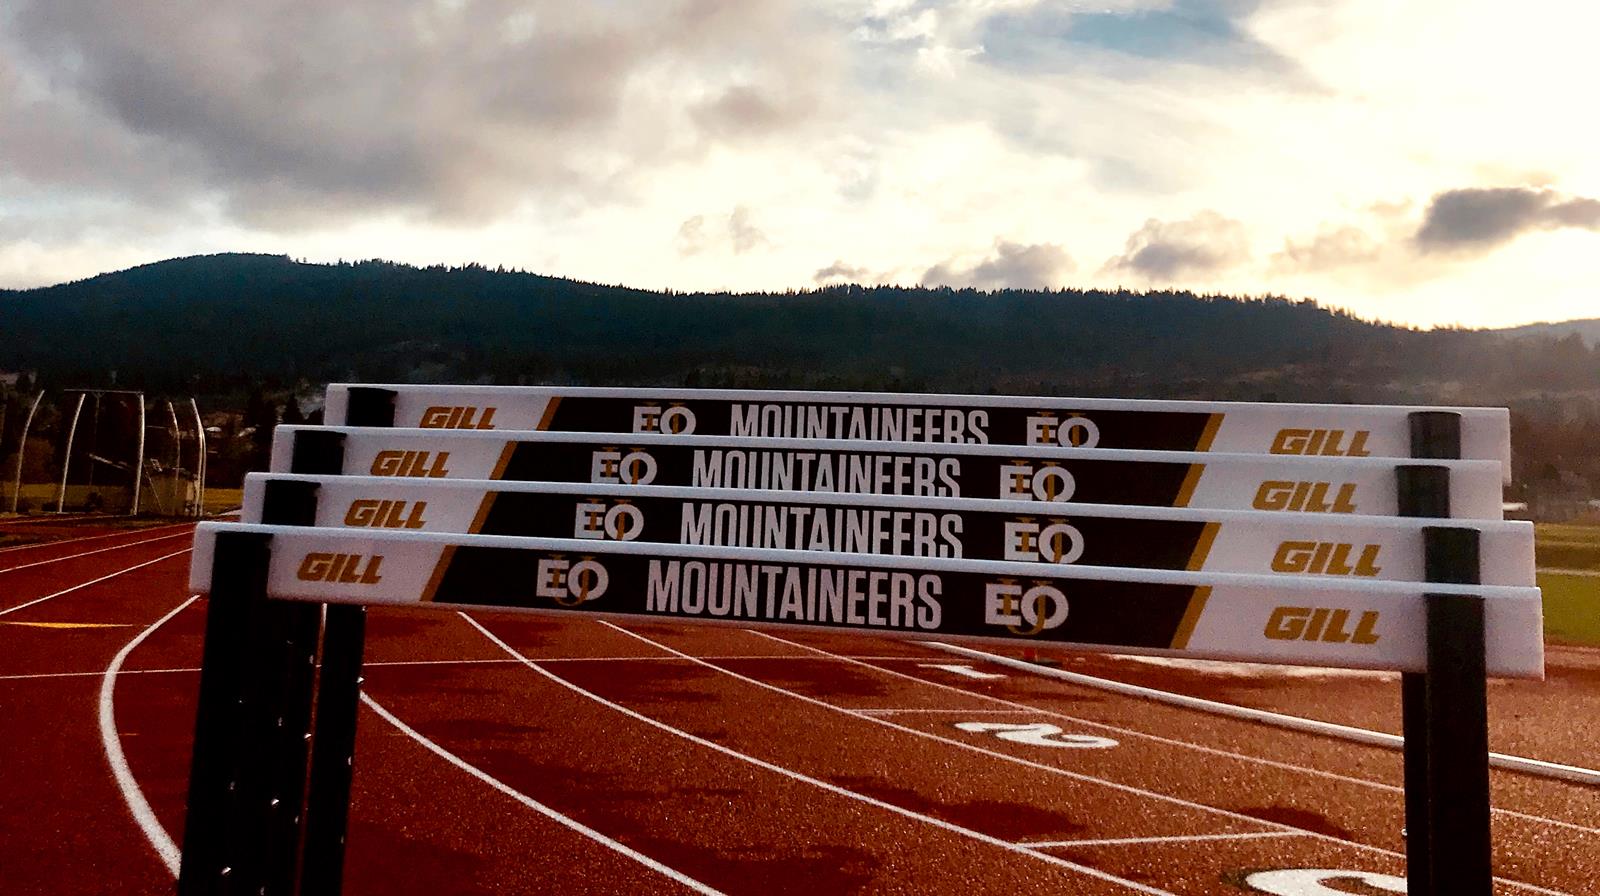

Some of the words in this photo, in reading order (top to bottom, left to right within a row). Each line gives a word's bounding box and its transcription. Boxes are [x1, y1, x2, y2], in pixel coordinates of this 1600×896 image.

[419, 406, 498, 430] GILL
[730, 404, 990, 446] MOUNTAINEERS
[1269, 428, 1371, 457] GILL
[370, 450, 450, 478] GILL
[692, 449, 961, 498] MOUNTAINEERS
[1252, 480, 1358, 513] GILL
[343, 499, 428, 529] GILL
[680, 502, 963, 559] MOUNTAINEERS
[297, 552, 385, 584] GILL
[1270, 540, 1382, 577] GILL
[645, 559, 942, 630] MOUNTAINEERS
[1264, 606, 1381, 645] GILL
[954, 721, 1120, 748] 2
